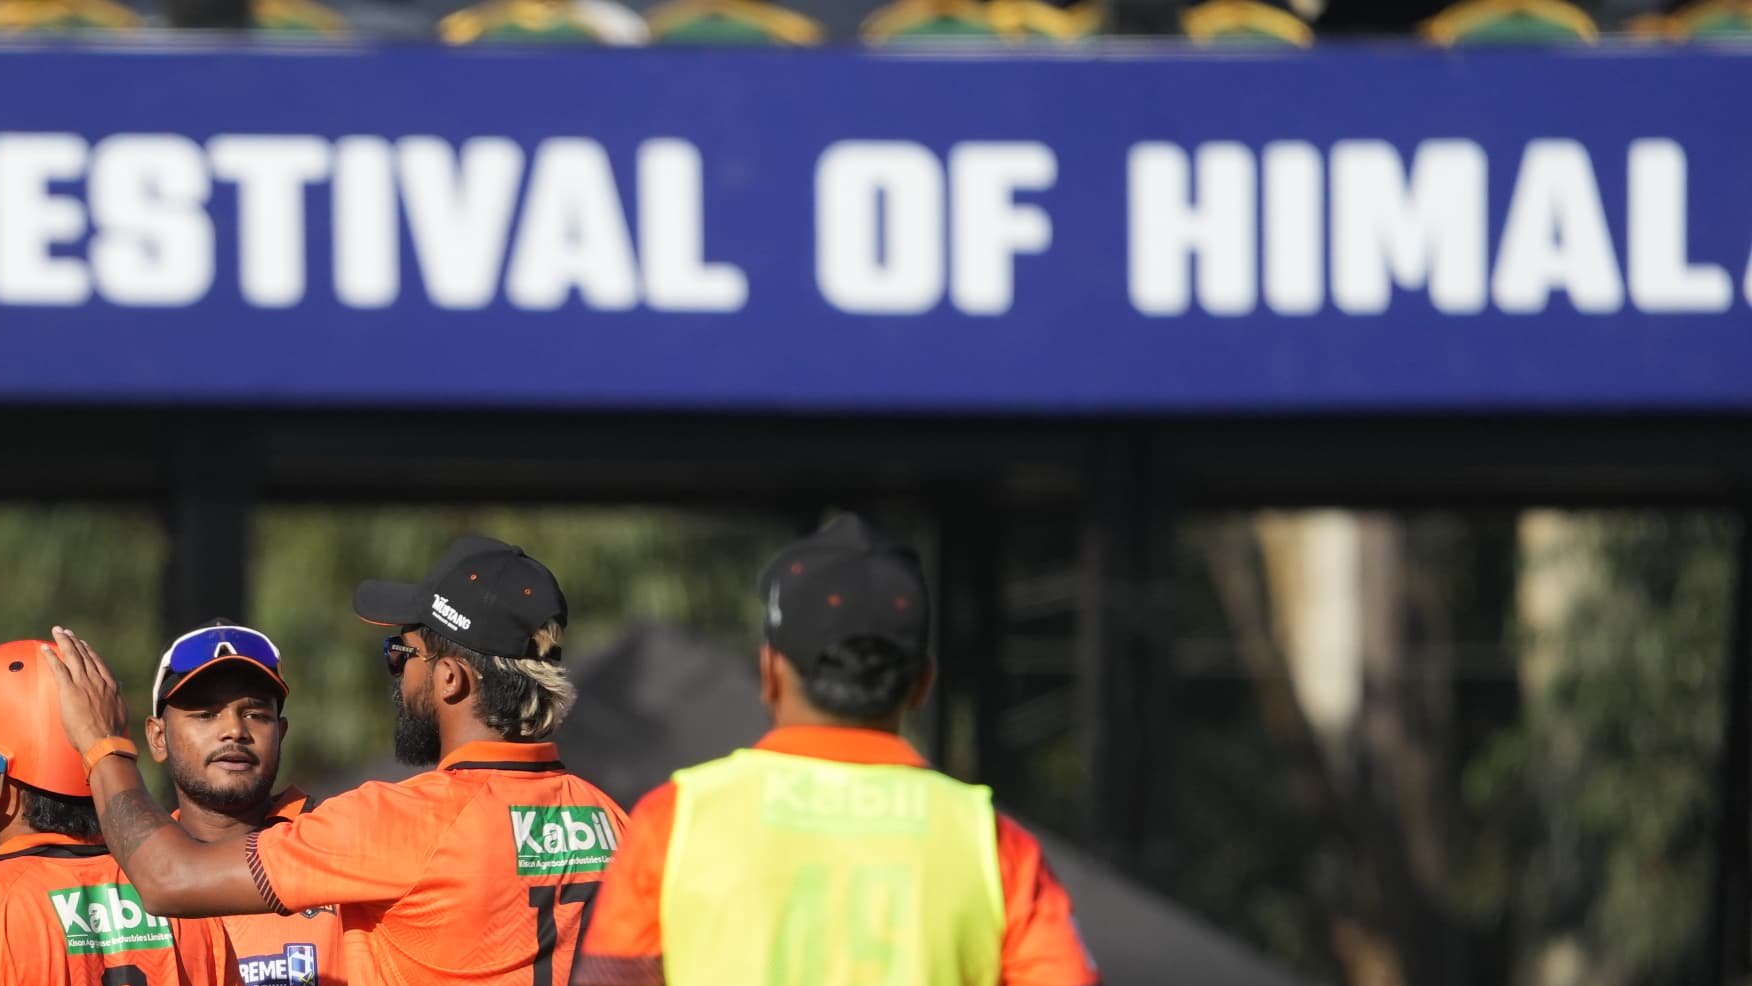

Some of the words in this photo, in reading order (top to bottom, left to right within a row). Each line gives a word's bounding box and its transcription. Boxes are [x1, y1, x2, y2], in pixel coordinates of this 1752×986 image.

[814, 139, 1058, 316] OF
[1125, 136, 1752, 317] HIMAL
[432, 594, 471, 629] MUSTANG
[511, 811, 617, 853] Kabil
[239, 959, 287, 983] REME
